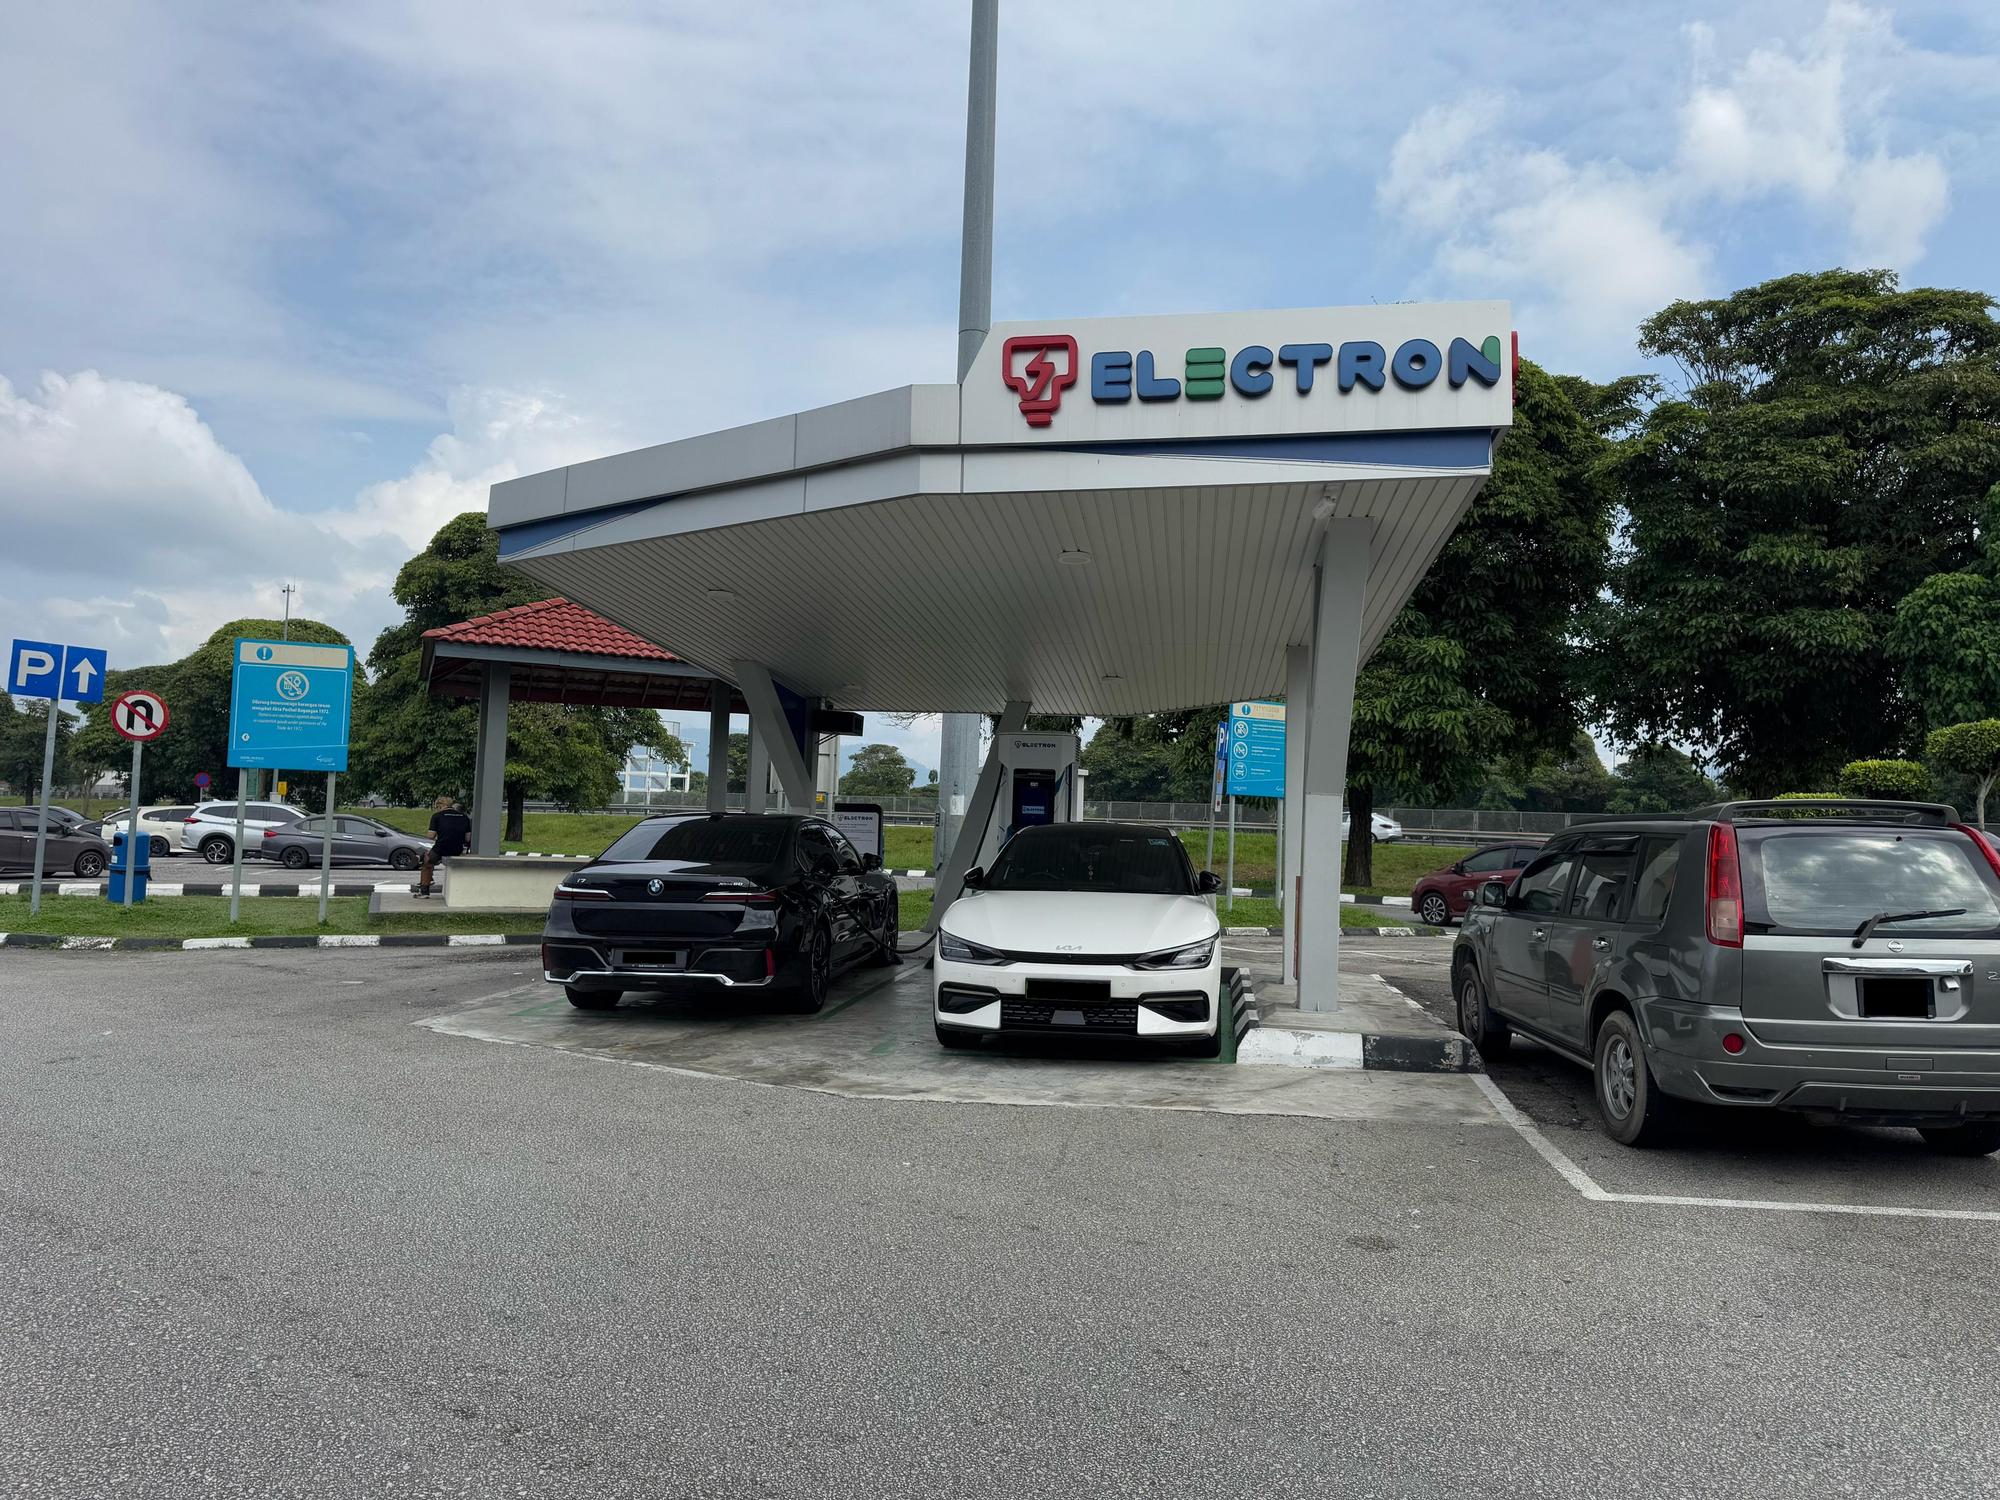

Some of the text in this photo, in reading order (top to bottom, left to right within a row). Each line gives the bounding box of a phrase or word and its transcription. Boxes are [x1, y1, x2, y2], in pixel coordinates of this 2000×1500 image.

[1090, 334, 1501, 404] ELECTRON
[16, 649, 55, 687] P
[1218, 727, 1225, 752] P
